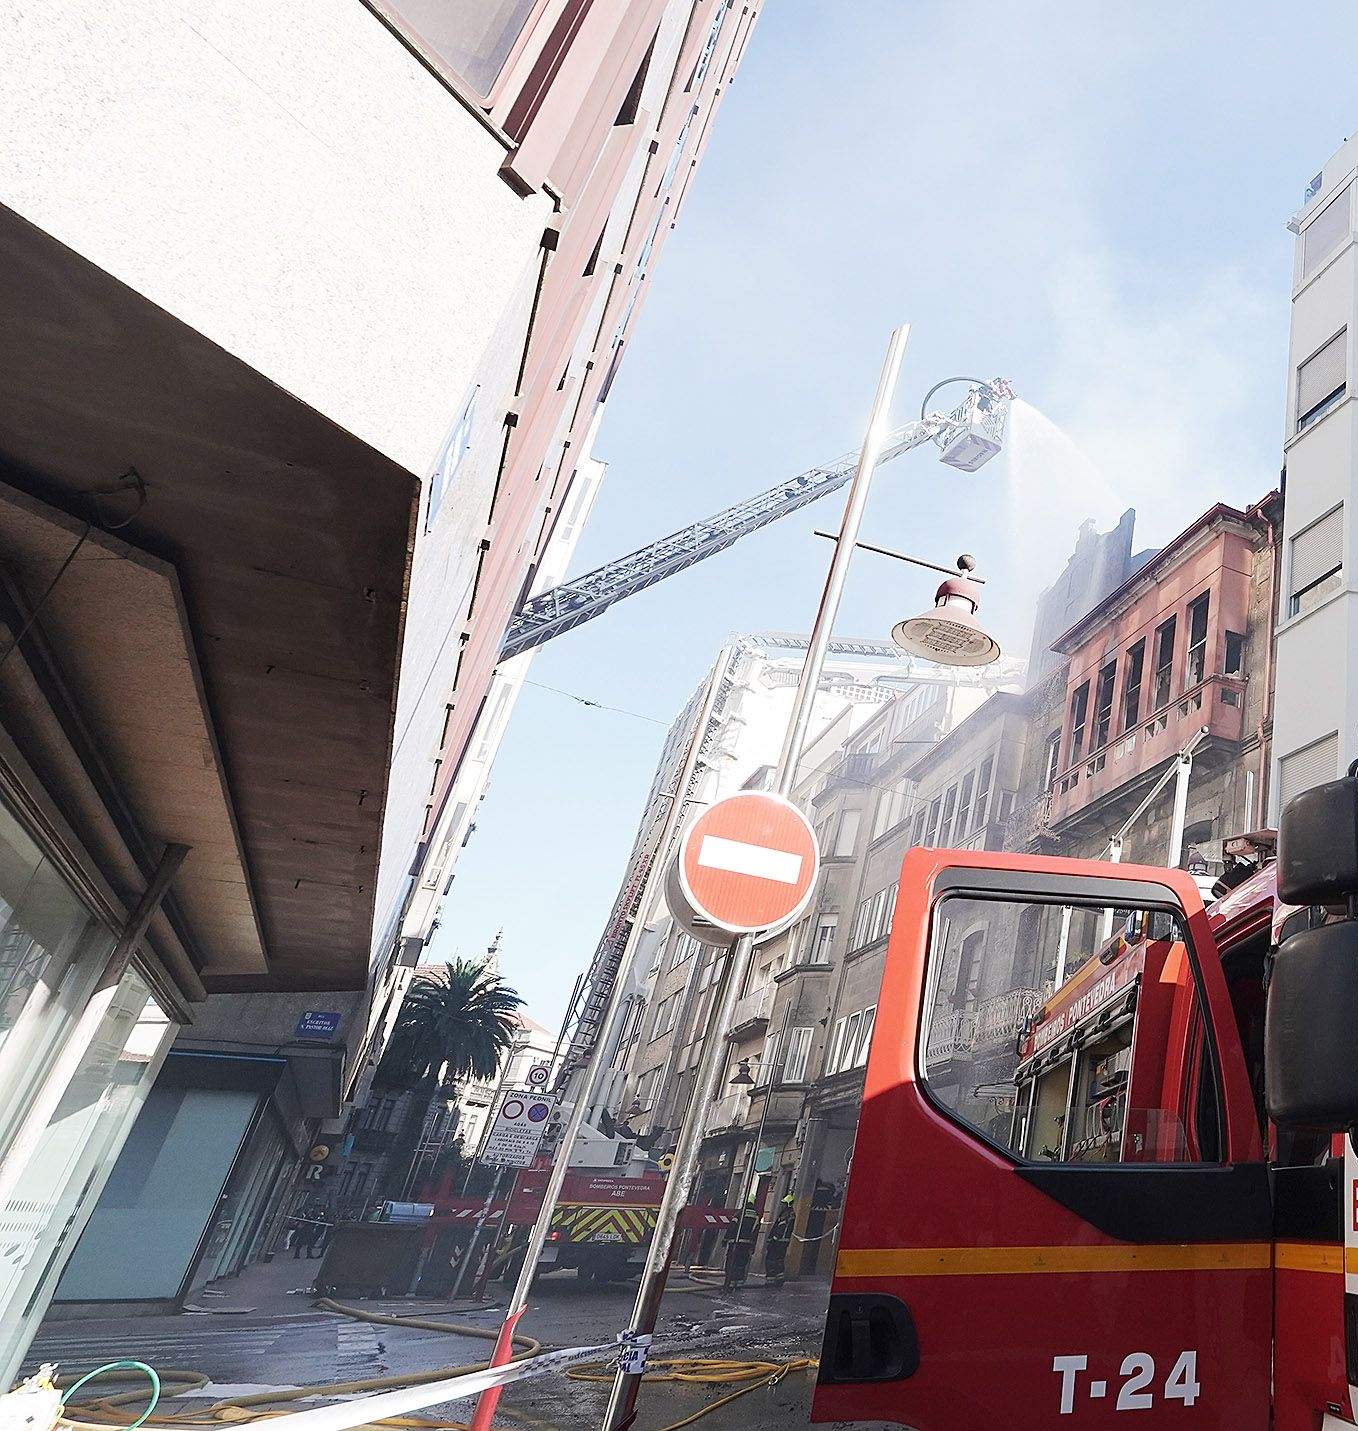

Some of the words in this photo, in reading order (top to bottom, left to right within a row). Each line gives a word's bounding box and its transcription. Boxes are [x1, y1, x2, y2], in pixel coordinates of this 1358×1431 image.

[534, 1072, 544, 1080] 10
[510, 1092, 528, 1100] ZONA
[306, 1164, 323, 1180] R
